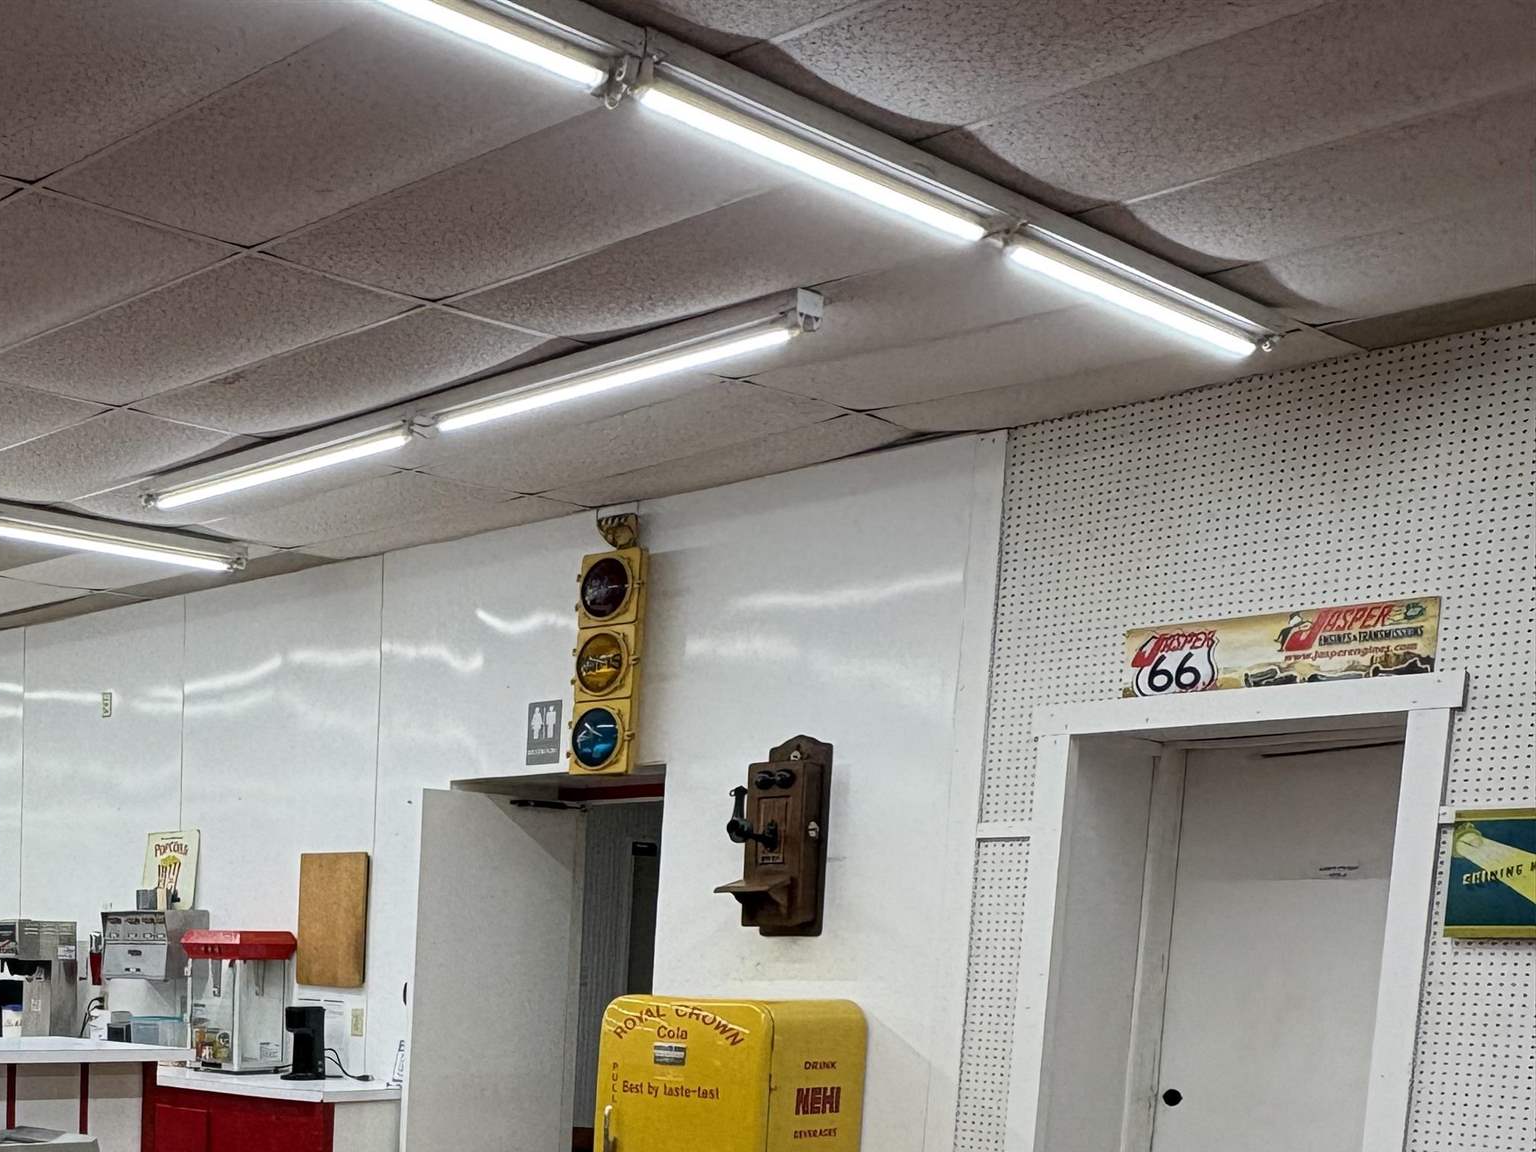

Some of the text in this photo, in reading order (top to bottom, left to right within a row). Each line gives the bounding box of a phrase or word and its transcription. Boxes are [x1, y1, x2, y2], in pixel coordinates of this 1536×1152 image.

[1284, 604, 1394, 652] JASPER
[1131, 629, 1216, 668] JASPER
[1148, 651, 1201, 692] 66
[1462, 864, 1523, 885] SHINING
[614, 1004, 744, 1046] ROYAL CROWN
[657, 1025, 688, 1039] Cola
[804, 1061, 837, 1070] DRINK
[622, 1080, 644, 1094] Best
[648, 1082, 659, 1097] by
[795, 1086, 841, 1115] NEHI
[793, 1127, 837, 1139] BEVERAGES
